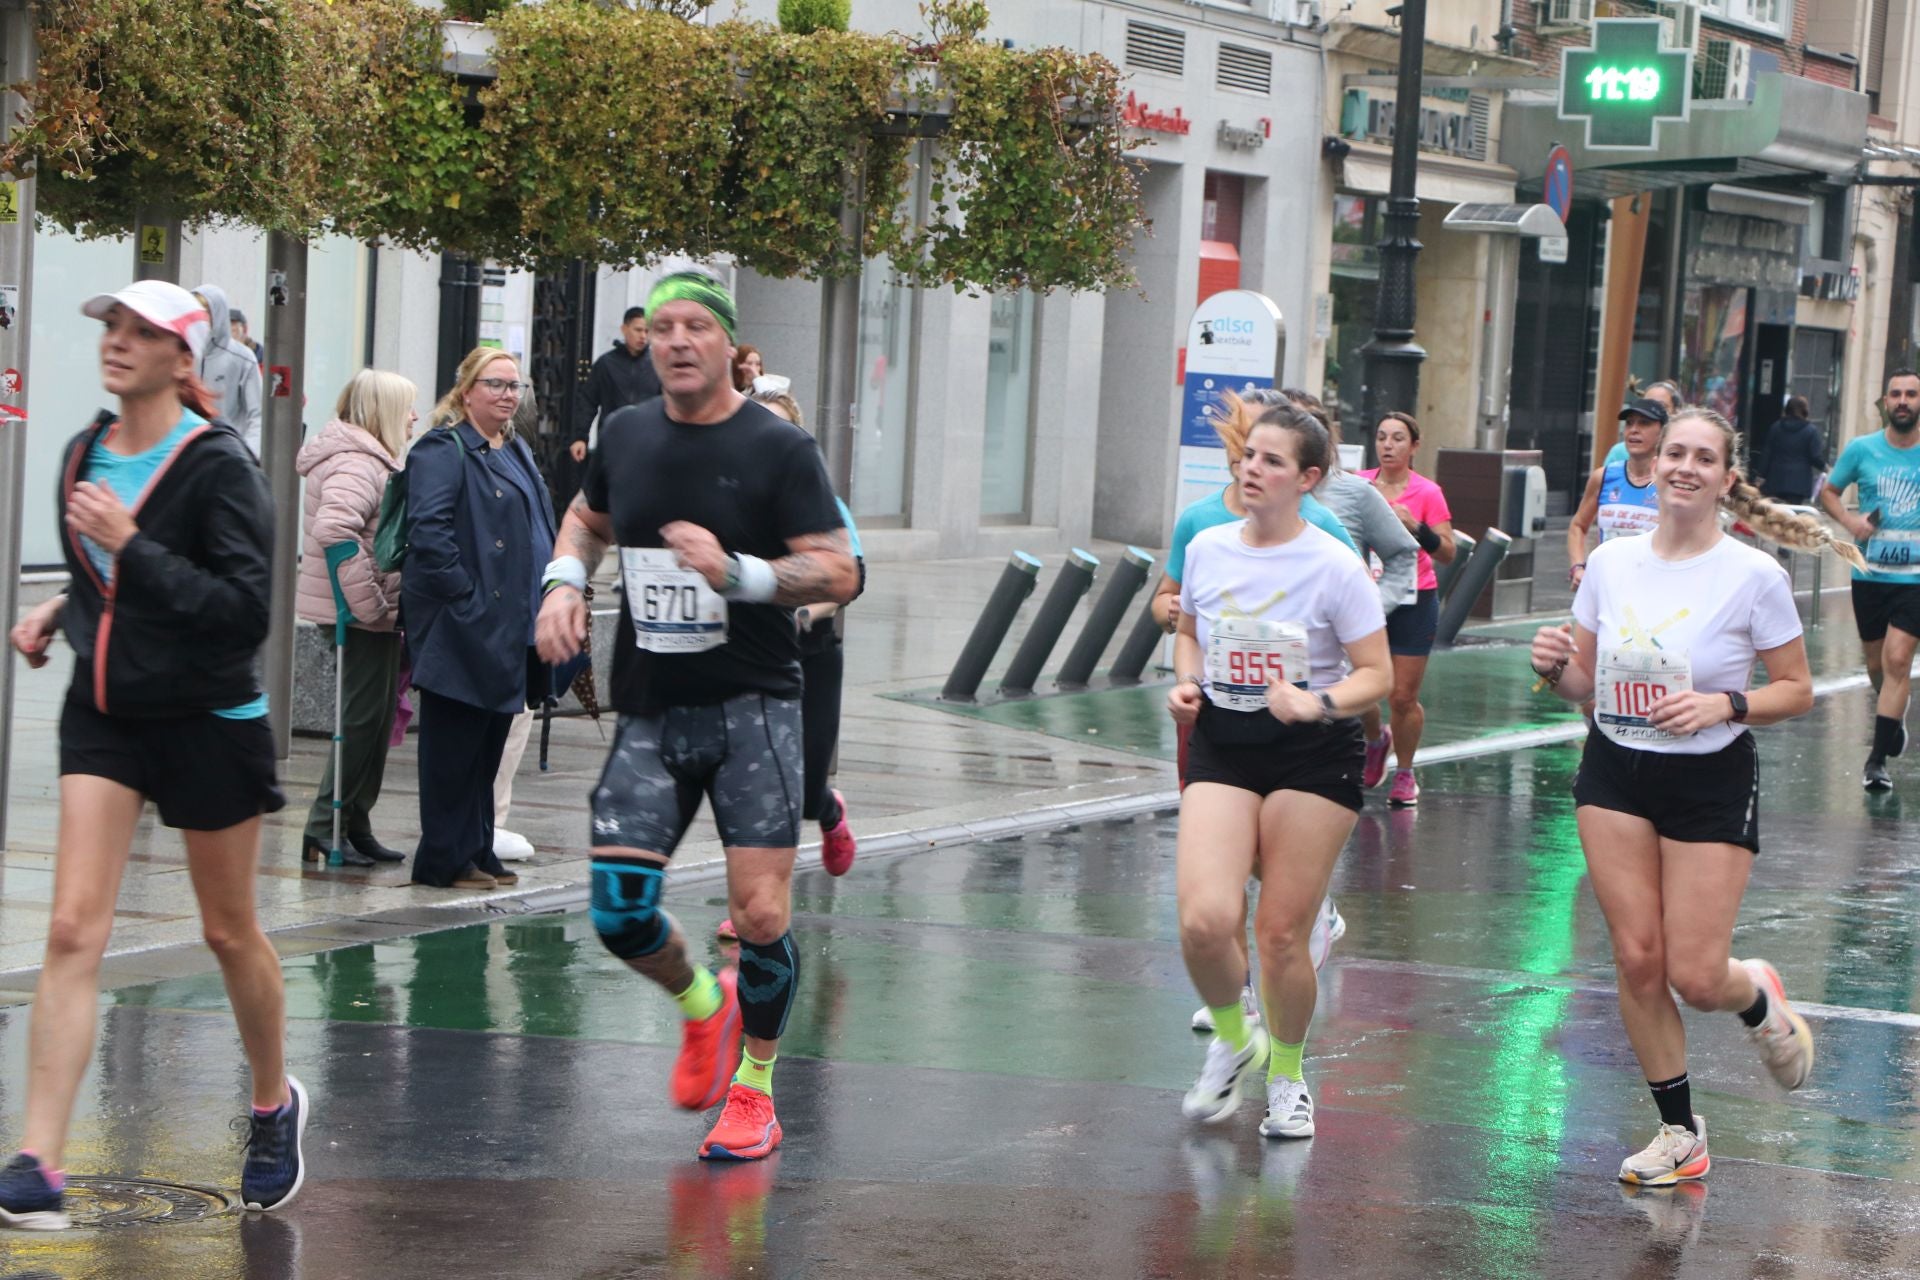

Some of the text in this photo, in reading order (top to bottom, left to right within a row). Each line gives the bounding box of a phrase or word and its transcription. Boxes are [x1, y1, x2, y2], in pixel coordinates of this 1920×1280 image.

[1585, 66, 1660, 100] 11:19
[1214, 316, 1254, 333] alsa
[644, 585, 697, 621] 670
[1229, 651, 1285, 685] 955
